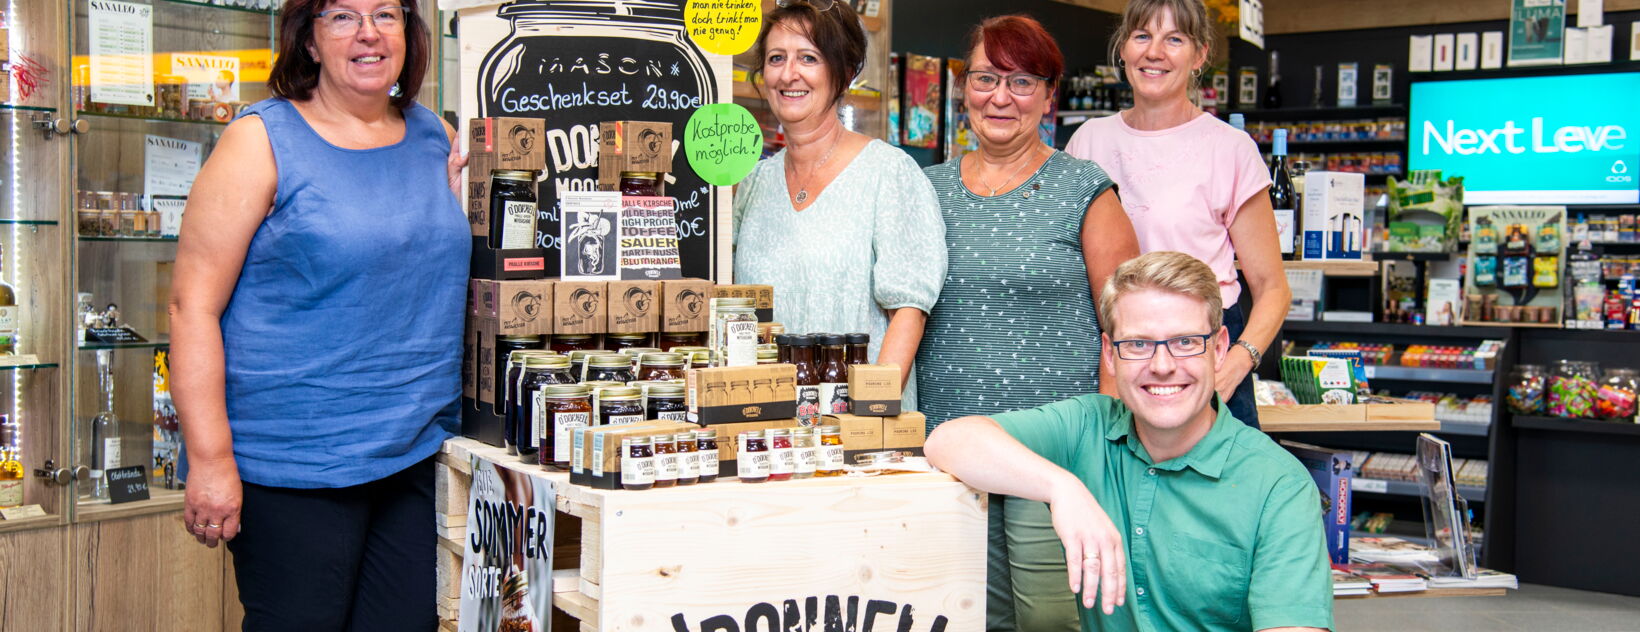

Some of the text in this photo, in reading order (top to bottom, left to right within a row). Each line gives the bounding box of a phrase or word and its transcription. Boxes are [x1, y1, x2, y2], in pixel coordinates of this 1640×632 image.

[91, 1, 135, 14] SANALEO
[711, 1, 723, 9] nie
[692, 12, 713, 24] doch
[693, 25, 742, 40] nie genug!
[176, 57, 234, 69] SANALEO
[692, 113, 755, 142] Kostprobe
[1423, 119, 1526, 155] Next
[147, 137, 187, 151] SANALEO
[1492, 210, 1546, 219] SANALEO
[644, 218, 674, 226] PROOF
[622, 227, 675, 236] TOFFEE
[621, 238, 676, 248] SAUER
[471, 498, 548, 561] SOMMER
[468, 565, 502, 599] SORTE
